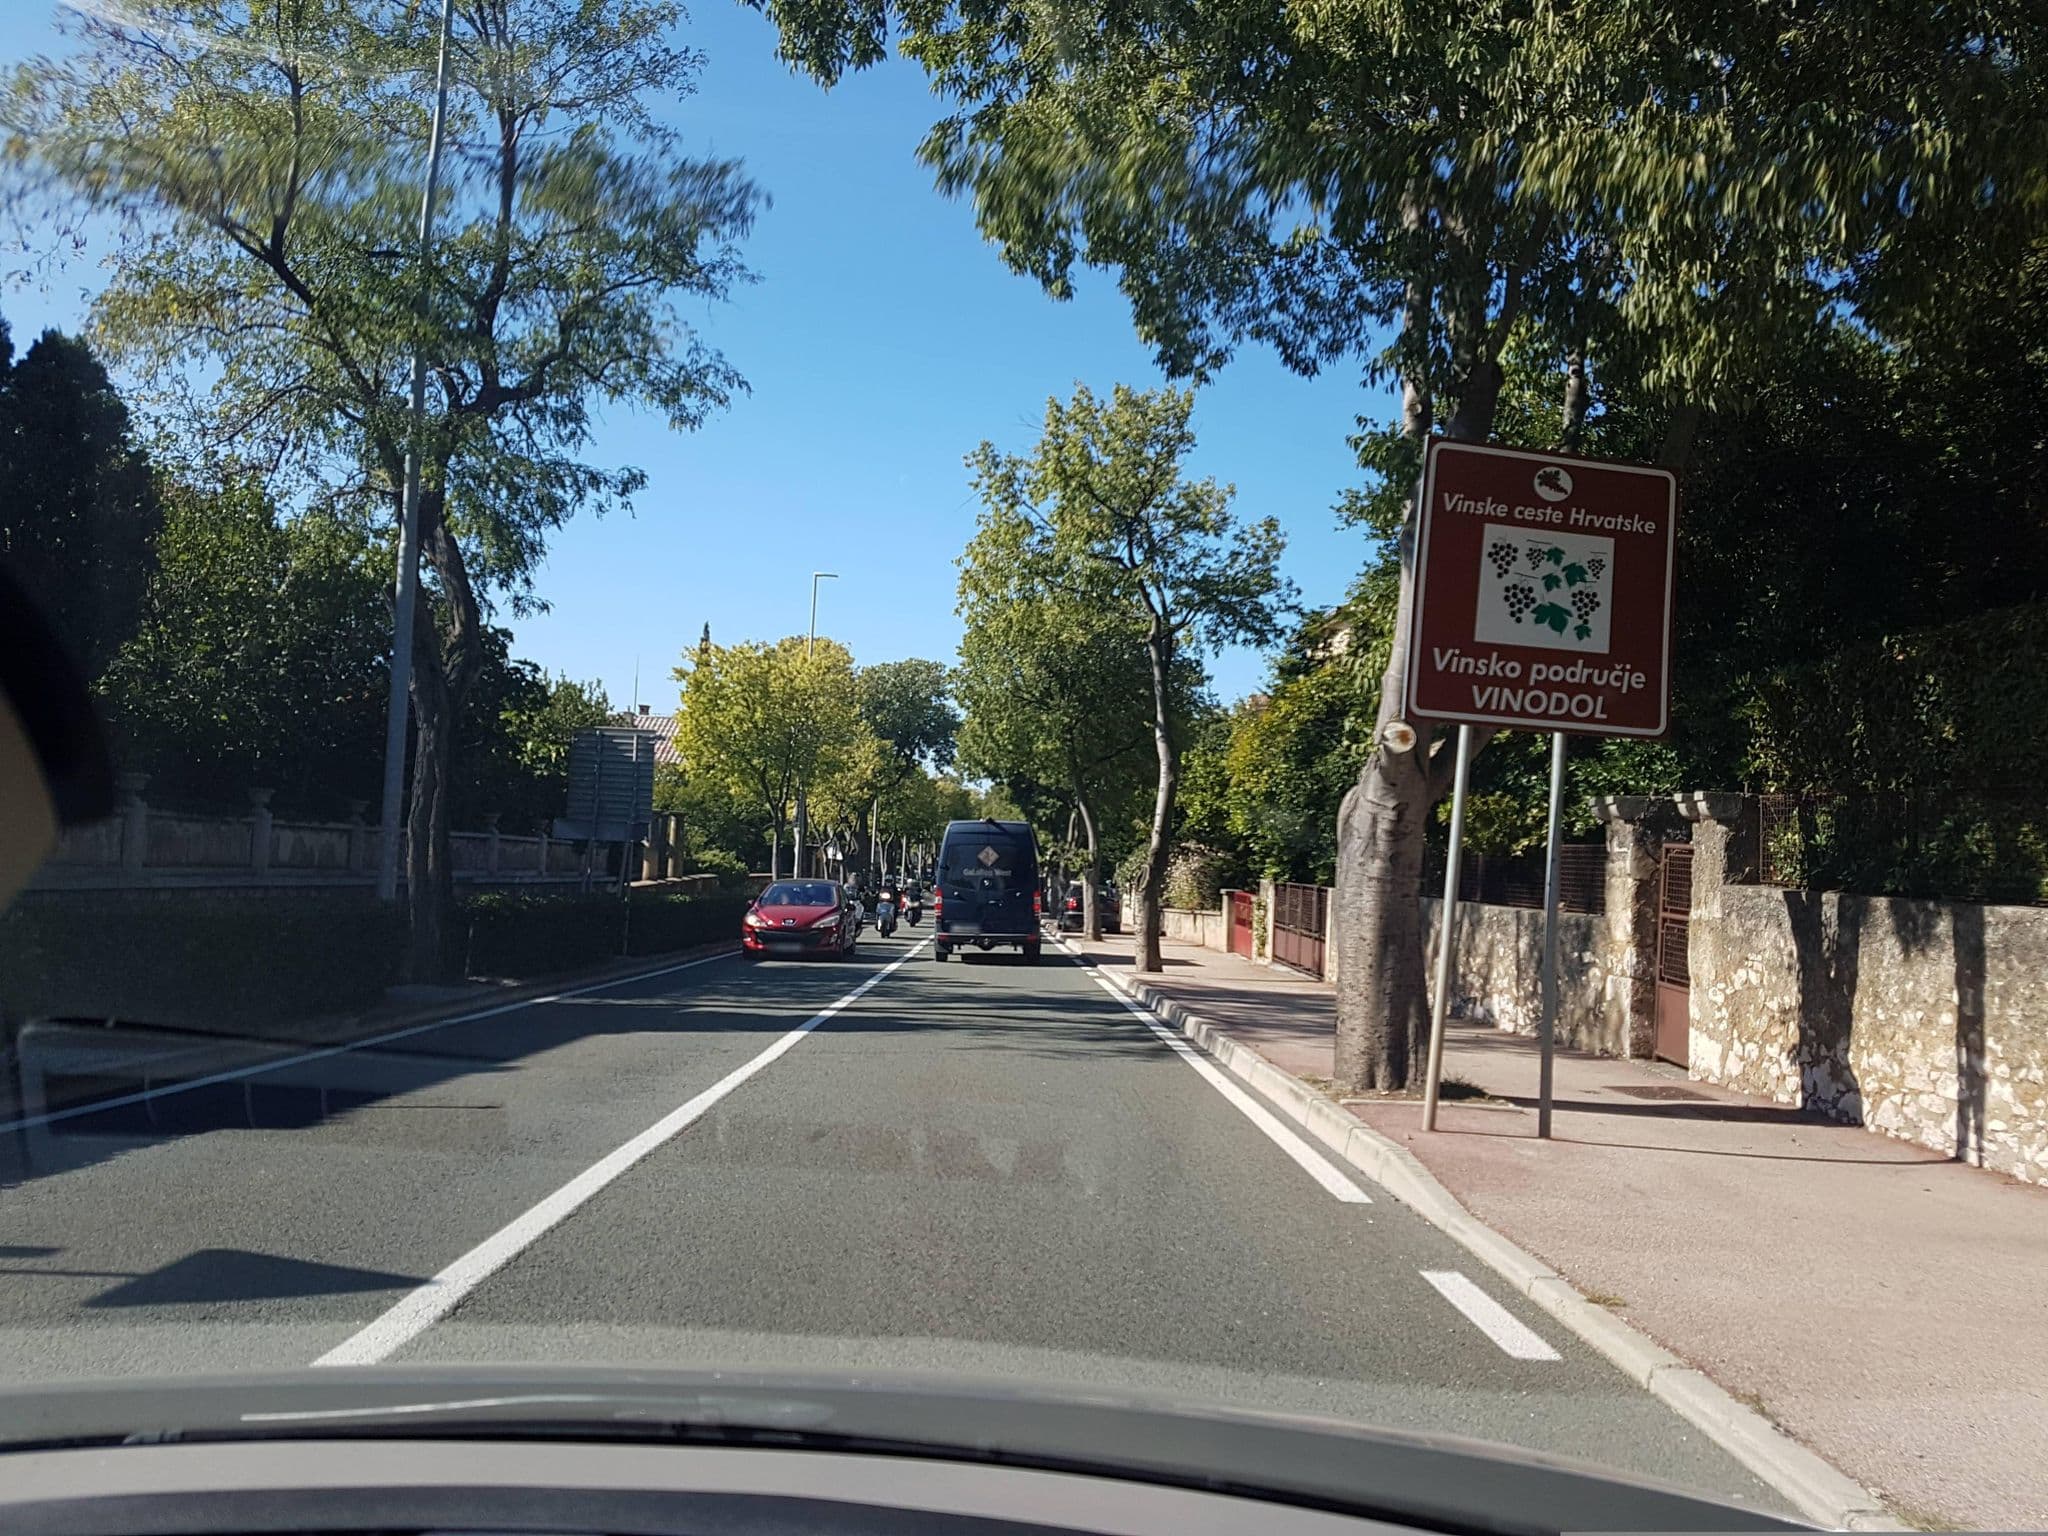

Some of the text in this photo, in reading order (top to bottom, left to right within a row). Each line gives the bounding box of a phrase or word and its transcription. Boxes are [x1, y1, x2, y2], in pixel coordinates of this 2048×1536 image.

[1443, 492, 1656, 534] Vinske ceste Hrvatske
[1433, 647, 1646, 693] Vinsko područje
[1472, 685, 1608, 719] VINODOL
